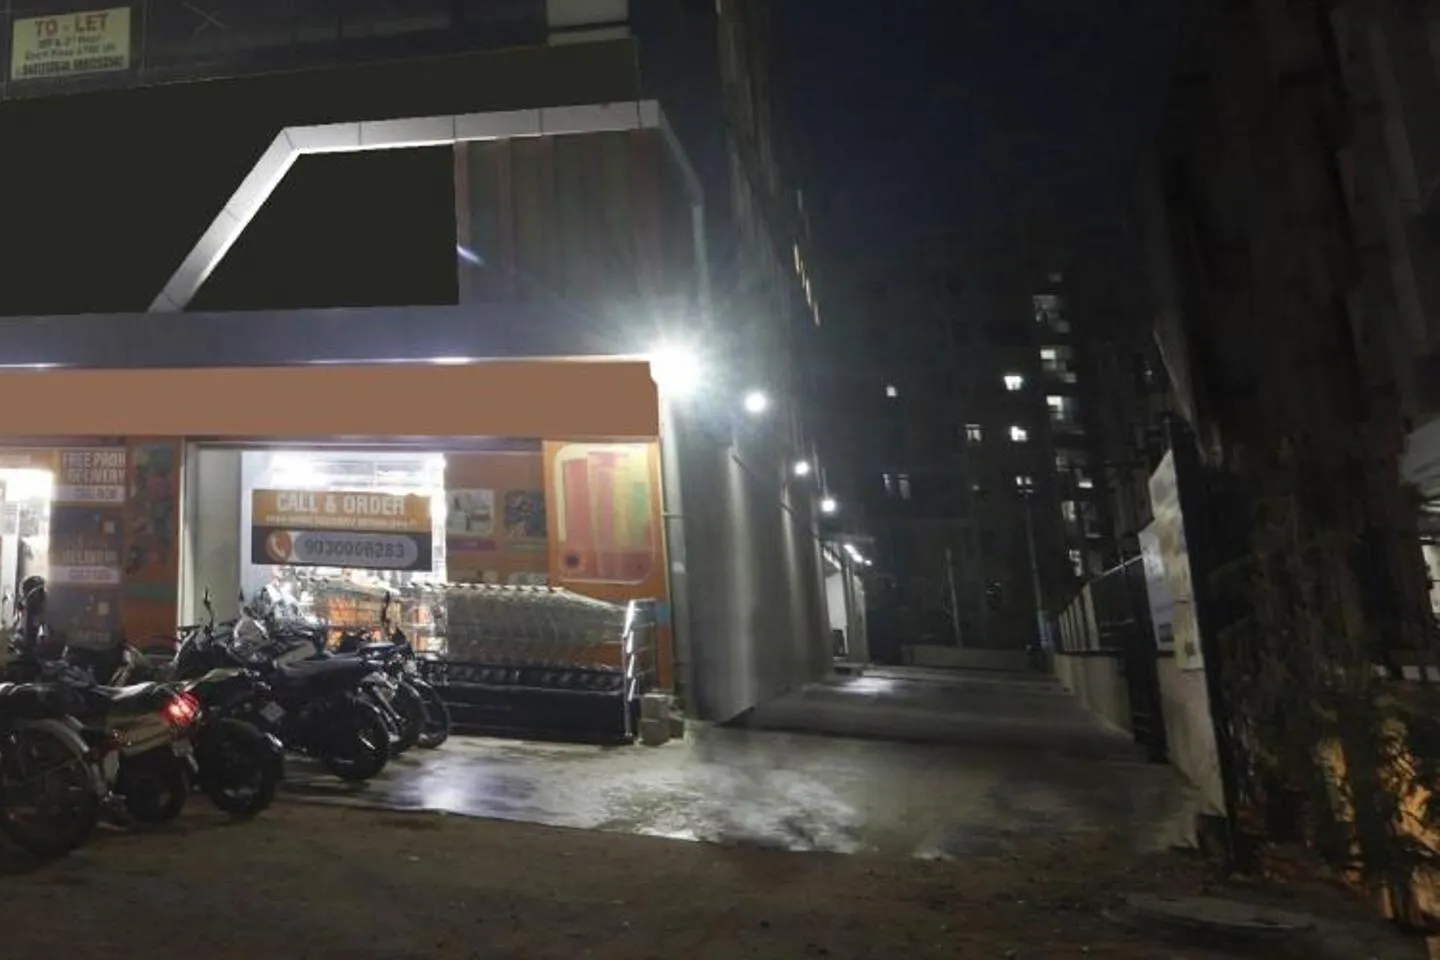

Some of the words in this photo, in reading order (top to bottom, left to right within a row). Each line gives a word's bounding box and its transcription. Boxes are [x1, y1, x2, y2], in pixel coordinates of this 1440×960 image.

[75, 12, 109, 32] LET
[276, 491, 318, 512] CALL
[324, 492, 337, 514] &
[342, 493, 406, 516] ORDER
